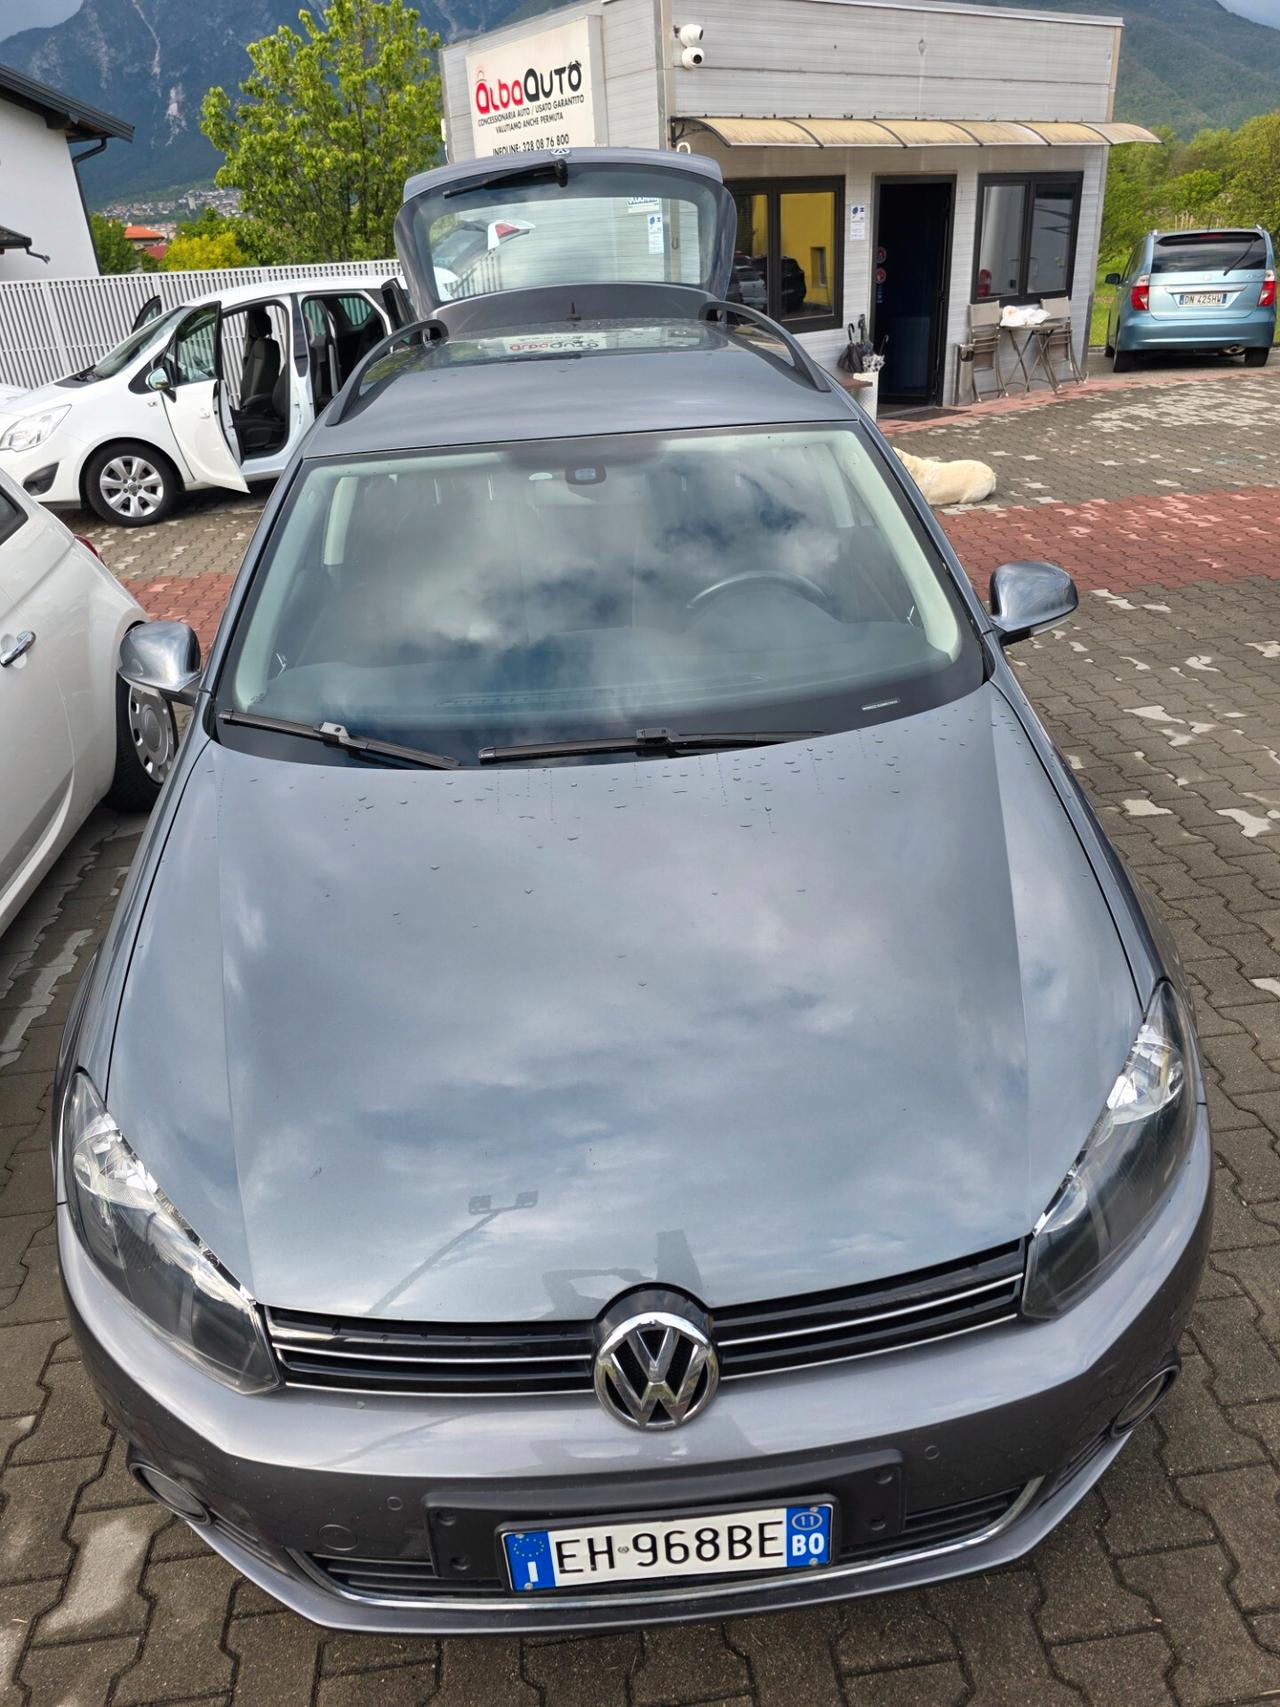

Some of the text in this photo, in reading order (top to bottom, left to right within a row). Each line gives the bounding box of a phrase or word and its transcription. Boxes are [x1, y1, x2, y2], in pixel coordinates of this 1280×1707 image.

[478, 111, 516, 127] CONCESSIONARIA
[517, 107, 531, 117] AUTO
[535, 102, 552, 113] USATO
[553, 94, 585, 109] GARANTITO
[523, 118, 540, 128] ANCHE
[540, 112, 564, 124] PERMUTA
[522, 140, 534, 152] 328
[536, 138, 544, 150] 08
[546, 136, 554, 147] 76
[556, 133, 569, 146] 800
[1184, 296, 1195, 304] DN
[555, 1535, 616, 1574] EH
[632, 1520, 784, 1567] 968BE
[792, 1532, 825, 1556] BO
